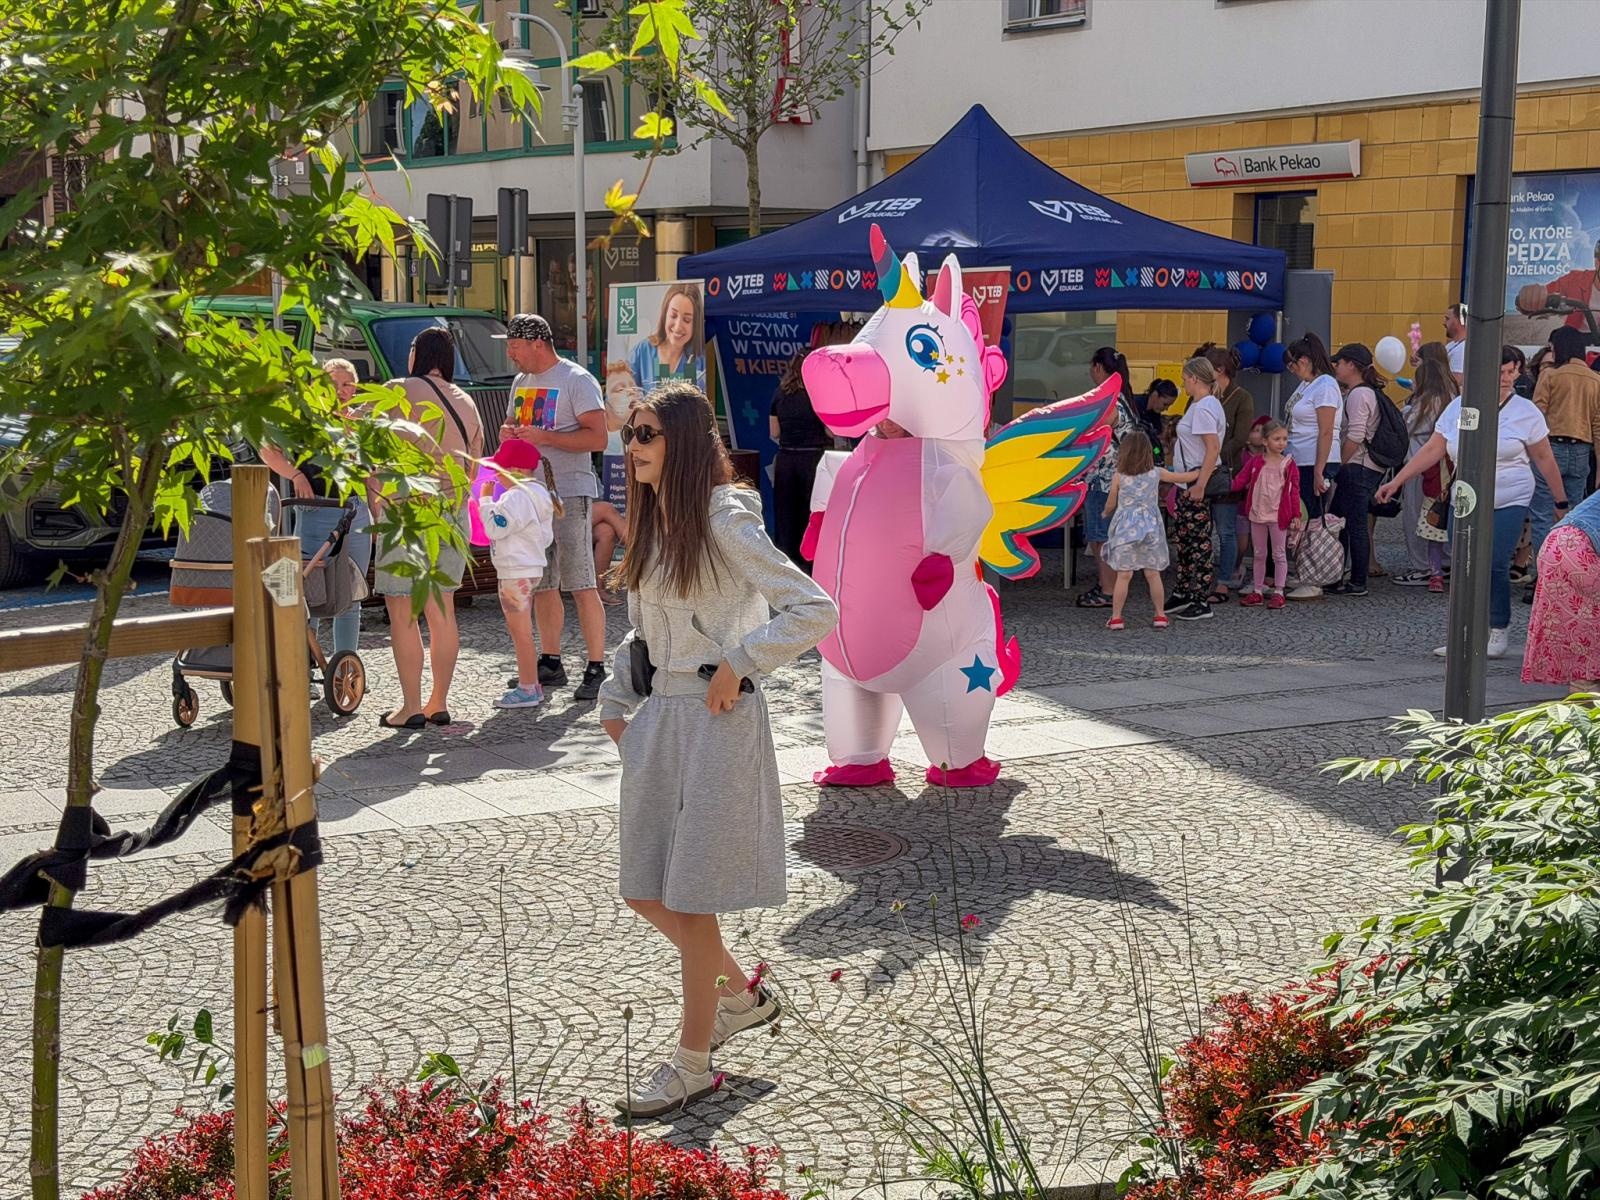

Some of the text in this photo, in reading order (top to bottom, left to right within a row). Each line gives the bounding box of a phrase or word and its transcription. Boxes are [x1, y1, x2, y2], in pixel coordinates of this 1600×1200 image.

[1244, 154, 1321, 173] Bank Pekao
[1526, 190, 1555, 203] Pekao
[875, 197, 923, 211] TEB
[1062, 200, 1112, 219] TEB
[862, 211, 906, 219] EDUKACJA
[1529, 224, 1573, 240] KTÓRE
[619, 247, 640, 260] TEB
[1507, 242, 1572, 264] PĘDZA
[743, 274, 765, 288] TEB
[1060, 268, 1084, 283] TEB
[986, 285, 1003, 298] TEB
[1059, 284, 1084, 292] EDUKACJA
[620, 298, 635, 306] TEB
[728, 320, 799, 338] UCZYMY
[731, 339, 749, 355] W
